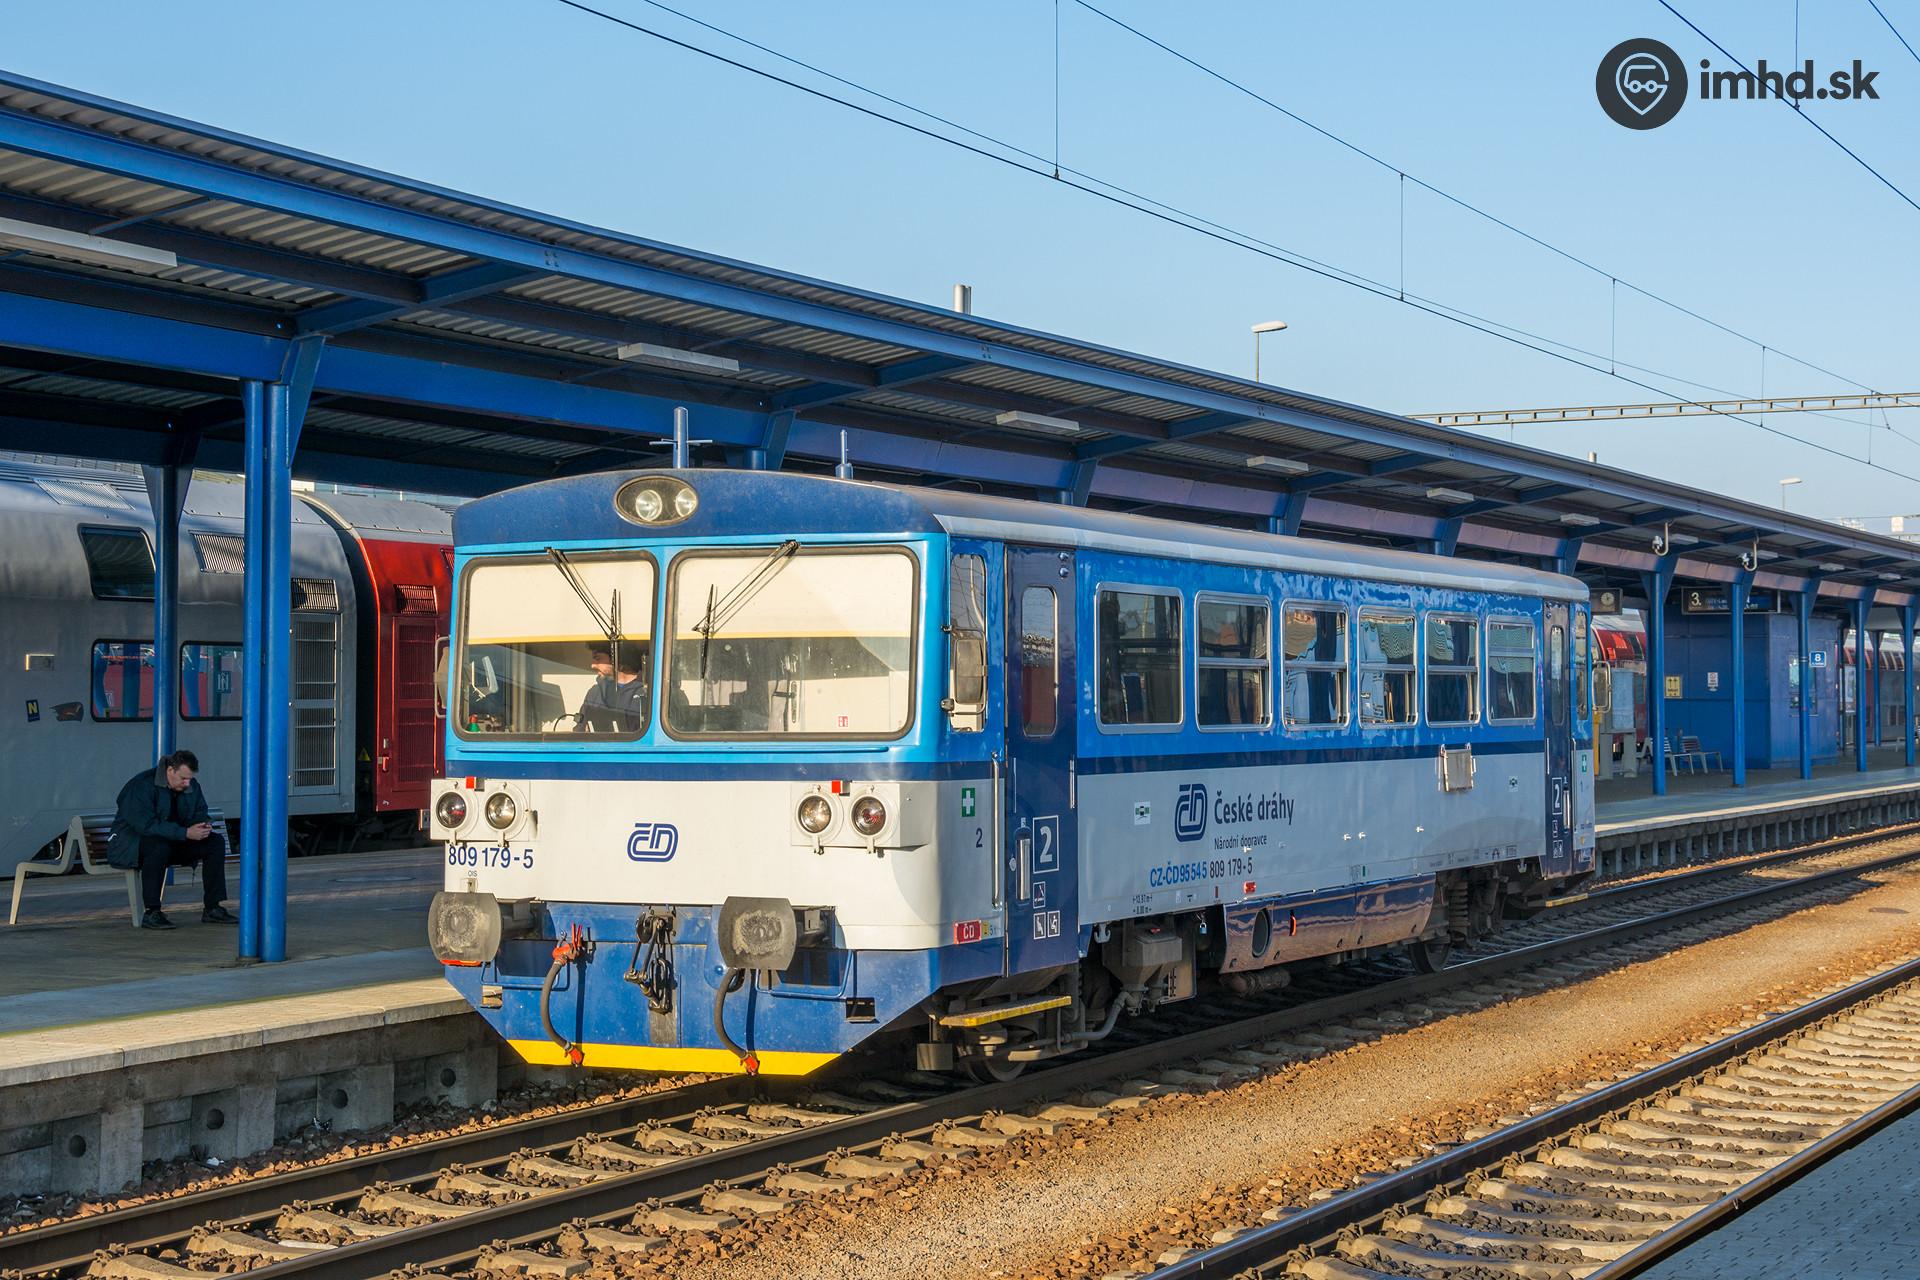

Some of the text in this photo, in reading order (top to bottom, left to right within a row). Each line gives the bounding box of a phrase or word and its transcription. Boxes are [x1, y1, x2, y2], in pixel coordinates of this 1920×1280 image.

[1554, 783, 1561, 809] 2
[1214, 789, 1295, 826] České dráhy
[975, 827, 984, 849] 2
[1039, 825, 1054, 864] 2
[1214, 834, 1267, 851] Národní dopravce
[448, 846, 478, 868] 809
[467, 870, 478, 878] OIS
[1209, 860, 1225, 879] 809
[963, 923, 975, 940] ČD
